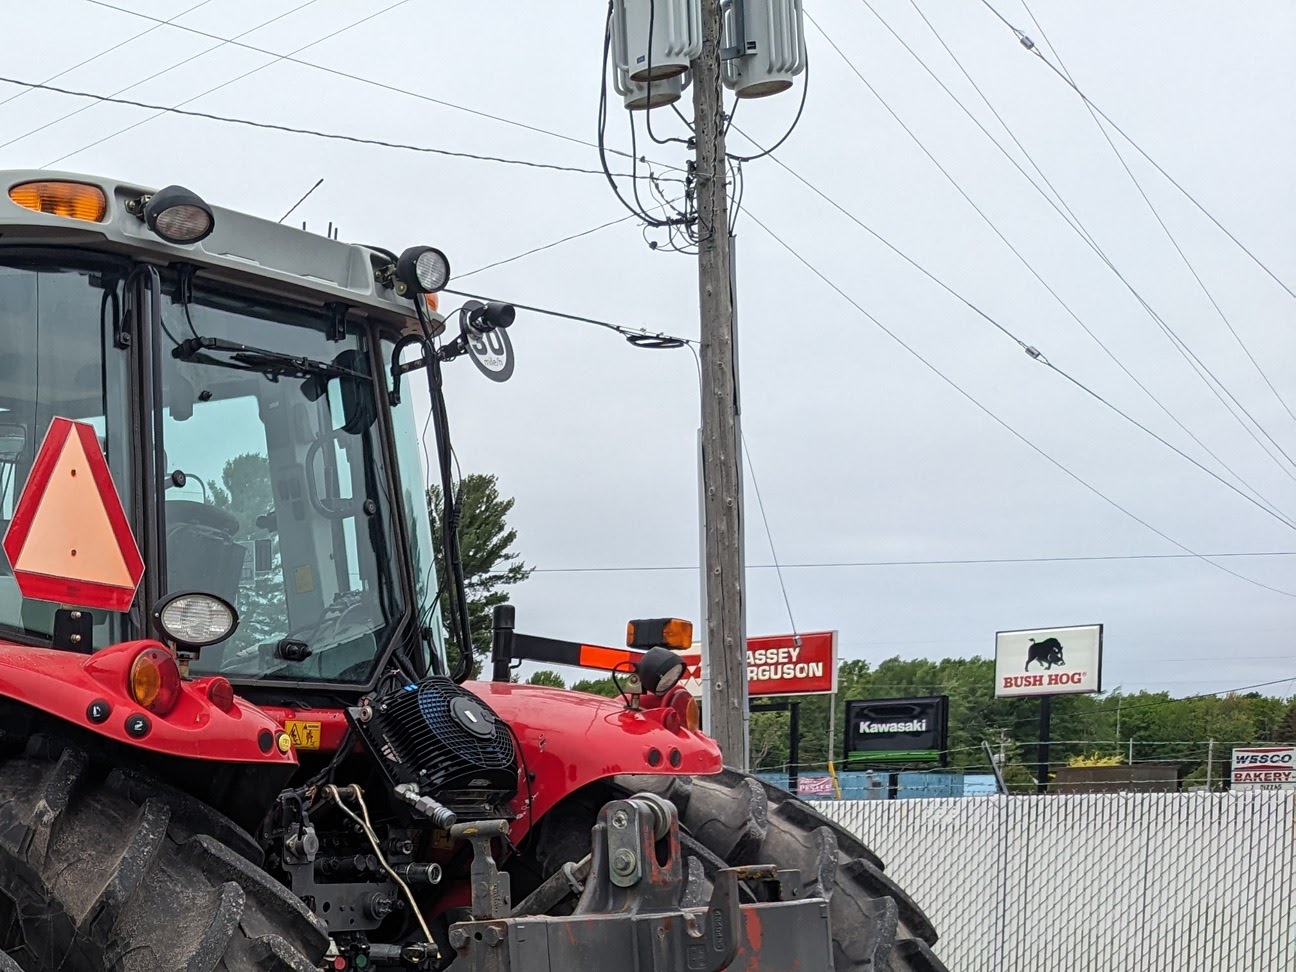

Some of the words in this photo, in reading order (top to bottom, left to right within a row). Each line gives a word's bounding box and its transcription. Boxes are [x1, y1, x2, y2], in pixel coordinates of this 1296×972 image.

[746, 647, 801, 665] ASSEY
[747, 661, 823, 681] RGUSON
[1003, 674, 1043, 688] BUSH
[859, 719, 927, 734] Kawasaki
[1235, 753, 1293, 765] WESCO
[1234, 771, 1292, 782] BAKERY
